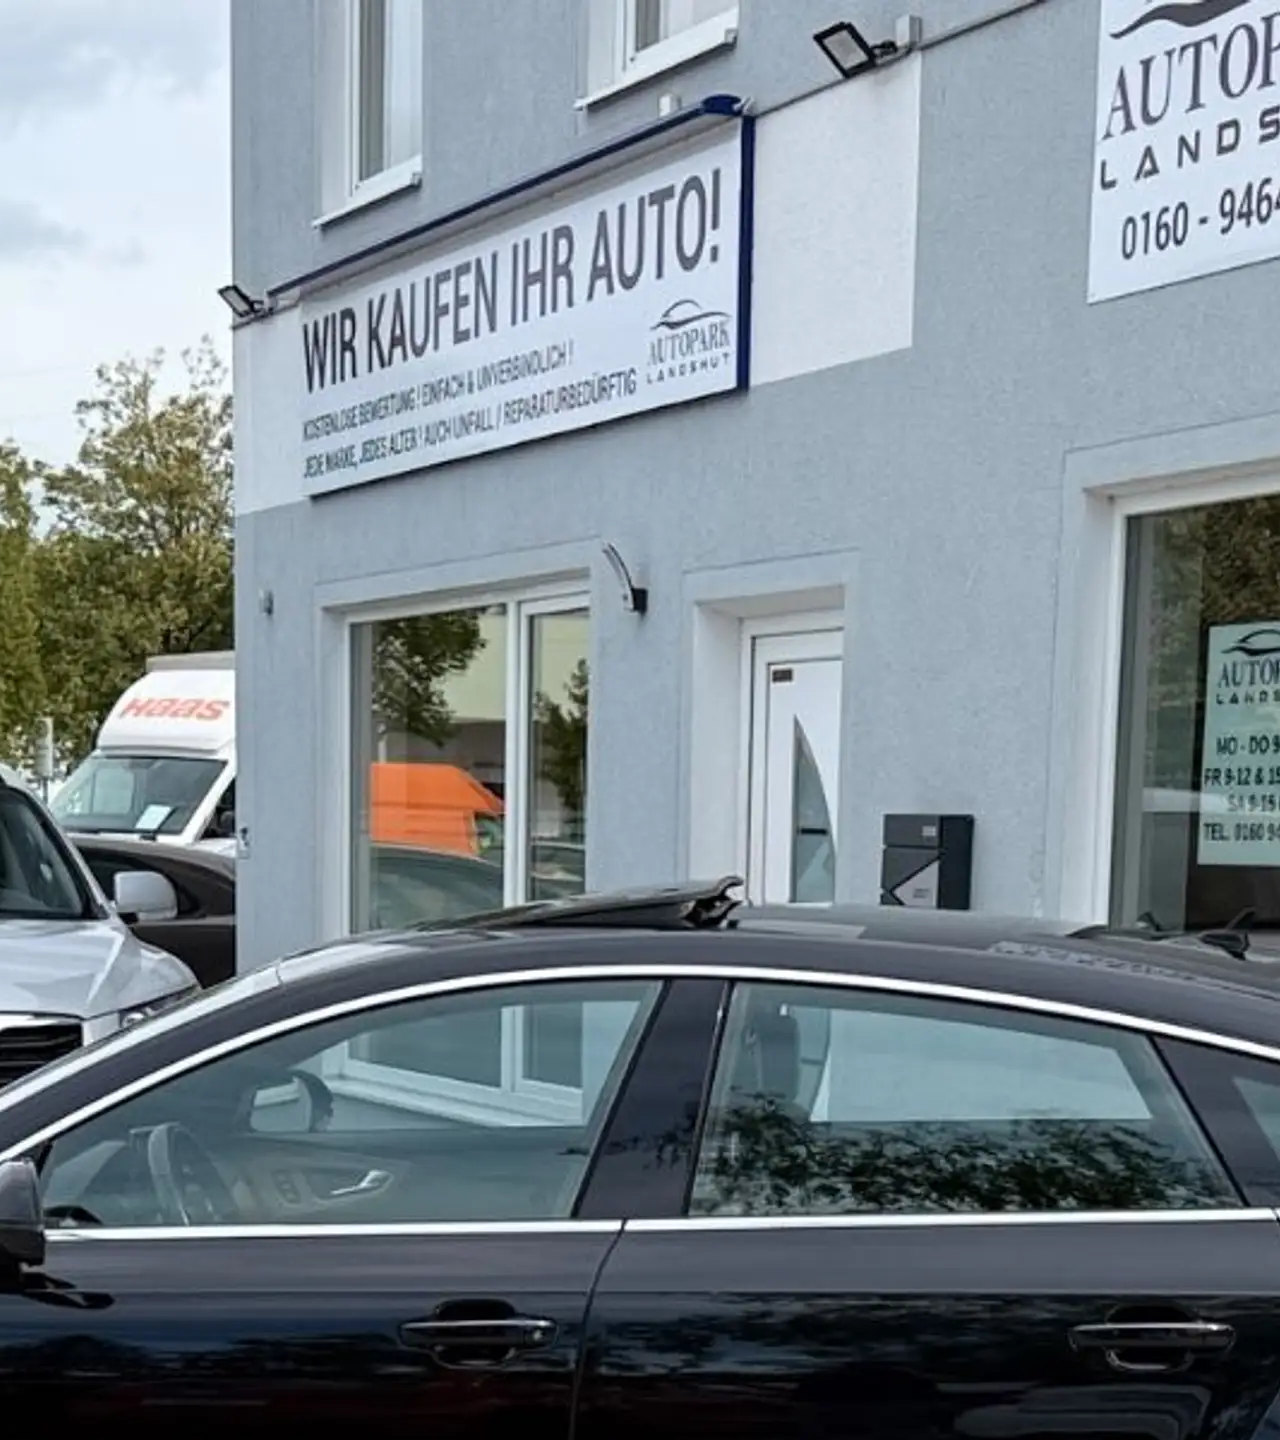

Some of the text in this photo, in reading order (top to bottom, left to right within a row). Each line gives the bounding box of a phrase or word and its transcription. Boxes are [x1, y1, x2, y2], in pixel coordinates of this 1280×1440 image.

[1121, 201, 1189, 261] 0160
[303, 168, 721, 394] WIR KAUFEN IHR AUTO!
[646, 352, 731, 385] LANDSHUT
[649, 320, 731, 367] AUTOPARK
[303, 405, 359, 442] KOSTENLOSE
[421, 372, 465, 407] EINFACH
[477, 342, 568, 390] UNVERBINDLICH
[388, 427, 418, 456] ALTER
[423, 419, 451, 446] AUCH
[451, 406, 494, 440] UNFALL
[503, 367, 637, 425] REPARATURBEDÜRFTIG
[1216, 735, 1238, 756] MO
[1249, 733, 1270, 755] DO
[1203, 767, 1222, 787] FR
